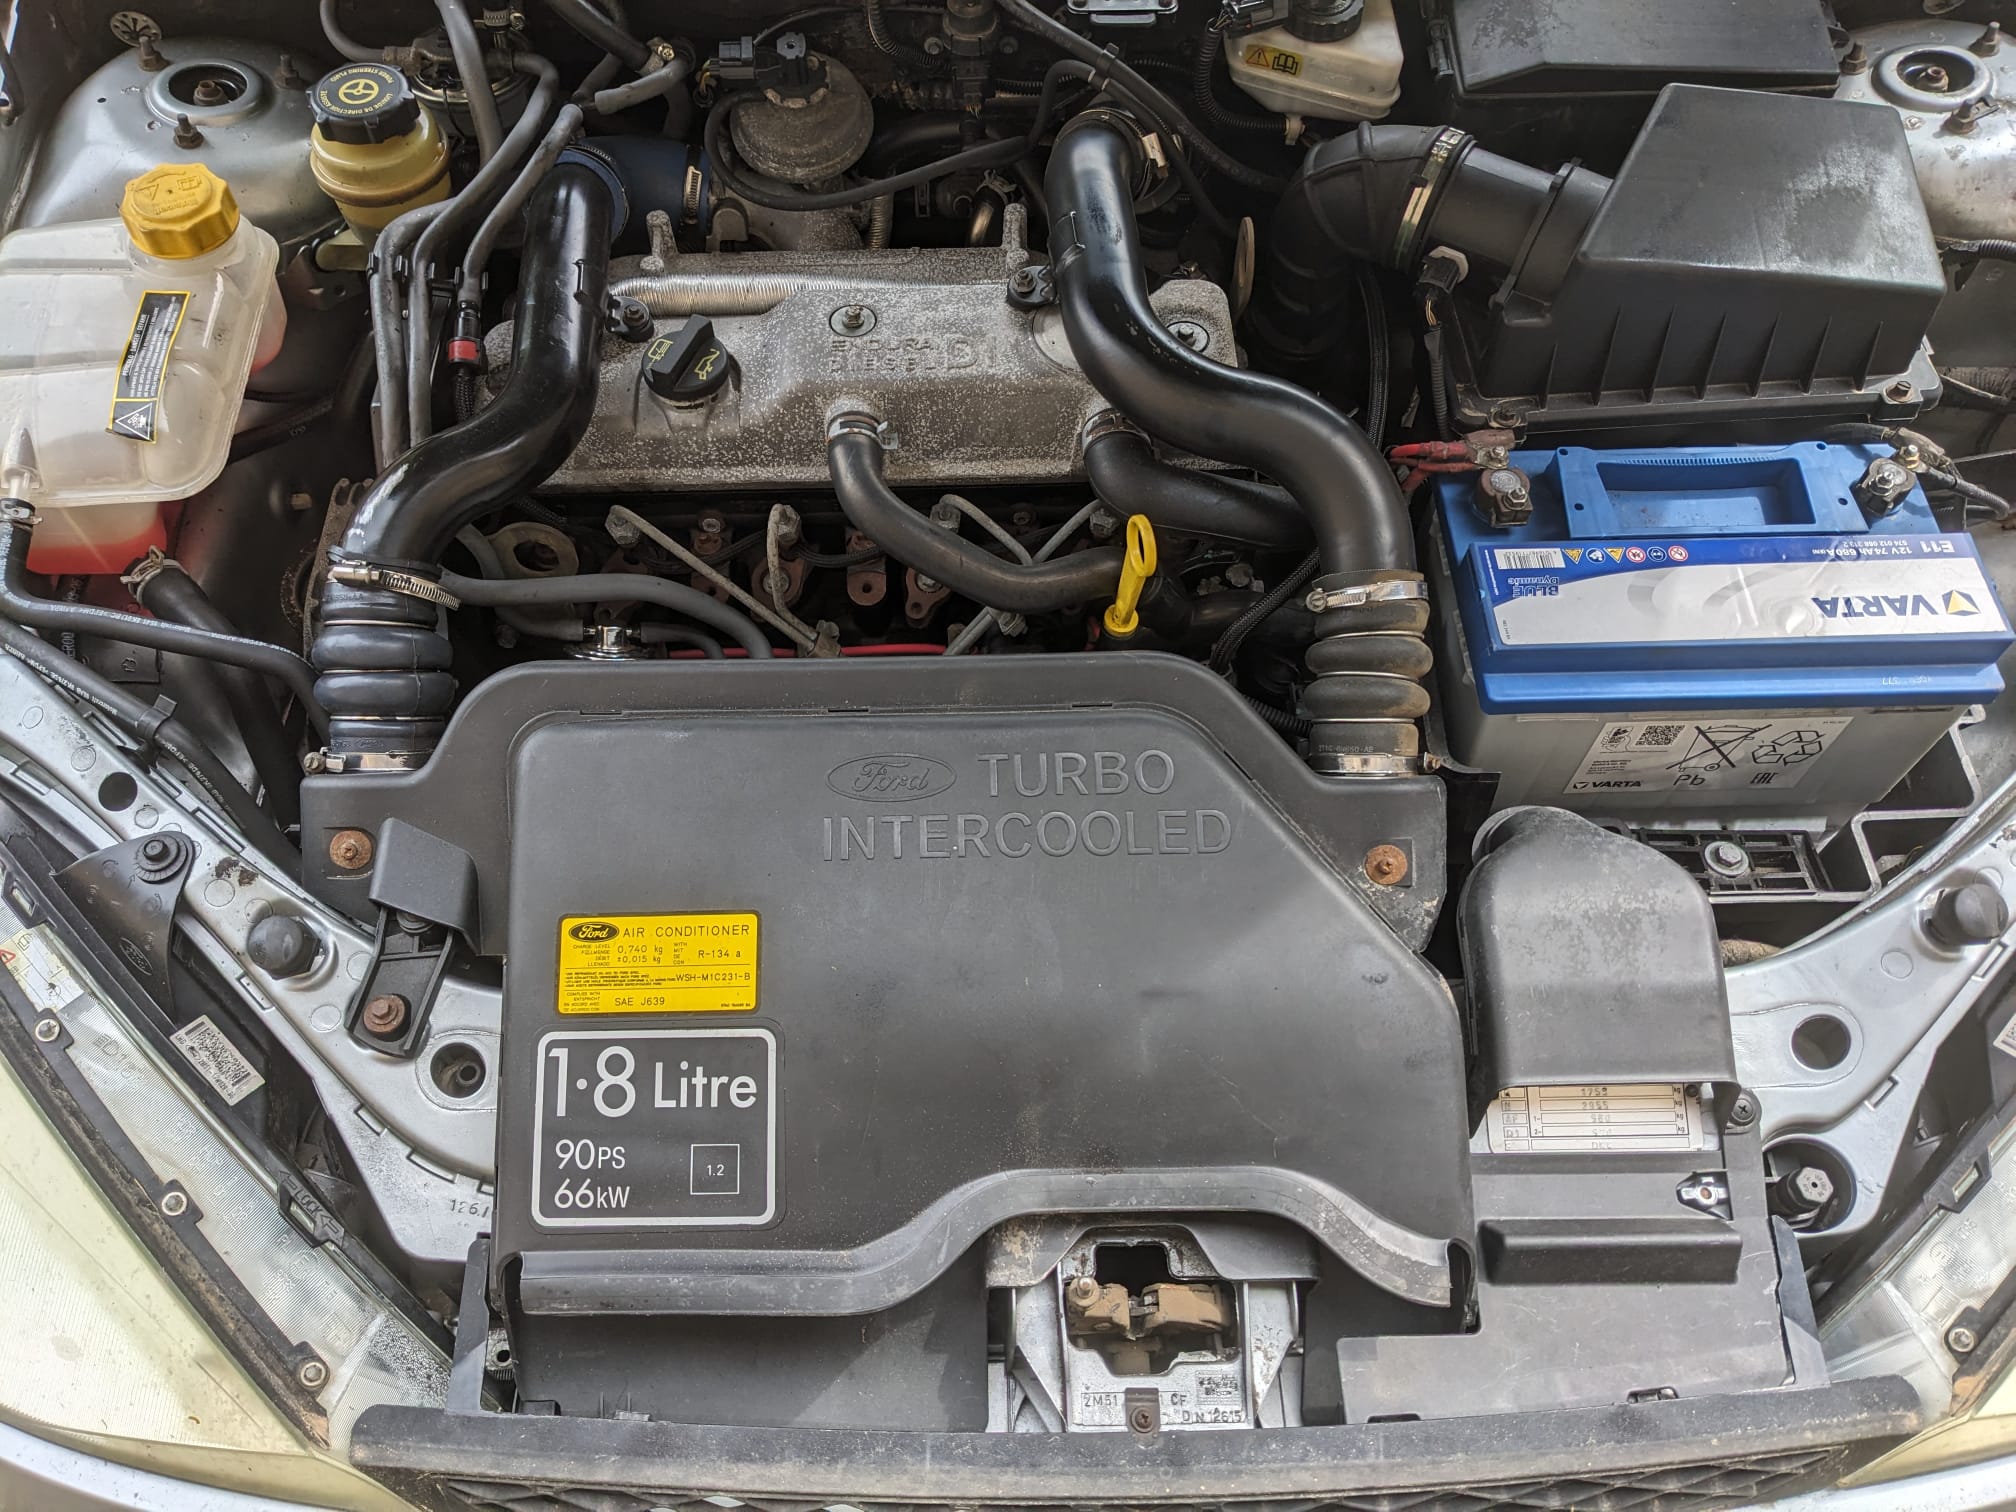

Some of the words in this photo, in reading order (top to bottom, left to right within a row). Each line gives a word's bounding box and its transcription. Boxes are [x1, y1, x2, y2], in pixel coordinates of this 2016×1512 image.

[1890, 546, 1912, 555] 12V
[1919, 540, 1955, 554] E11
[1512, 585, 1559, 597] BLUE
[1811, 594, 1939, 618] VARTA
[851, 760, 930, 793] Ford
[976, 749, 1175, 798] TURBO
[1673, 774, 1706, 786] Pb
[823, 809, 1232, 861] INTERCOOLED
[578, 924, 609, 939] Ford
[623, 927, 645, 938] AIR
[655, 924, 750, 938] CONDITIONER
[617, 945, 648, 955] 0,740
[654, 945, 663, 955] kg
[698, 950, 730, 958] R-134
[735, 950, 741, 958] a
[652, 956, 661, 964] kg
[614, 997, 634, 1007] SAE
[640, 997, 665, 1006] J639
[654, 1060, 757, 1108] Litre
[555, 1139, 626, 1170] 90PS
[706, 1164, 725, 1177] 1.2
[554, 1178, 630, 1209] 66kW
[294, 1188, 324, 1214] LOCK
[1083, 1394, 1119, 1407] 2M51
[1171, 1393, 1188, 1407] CF
